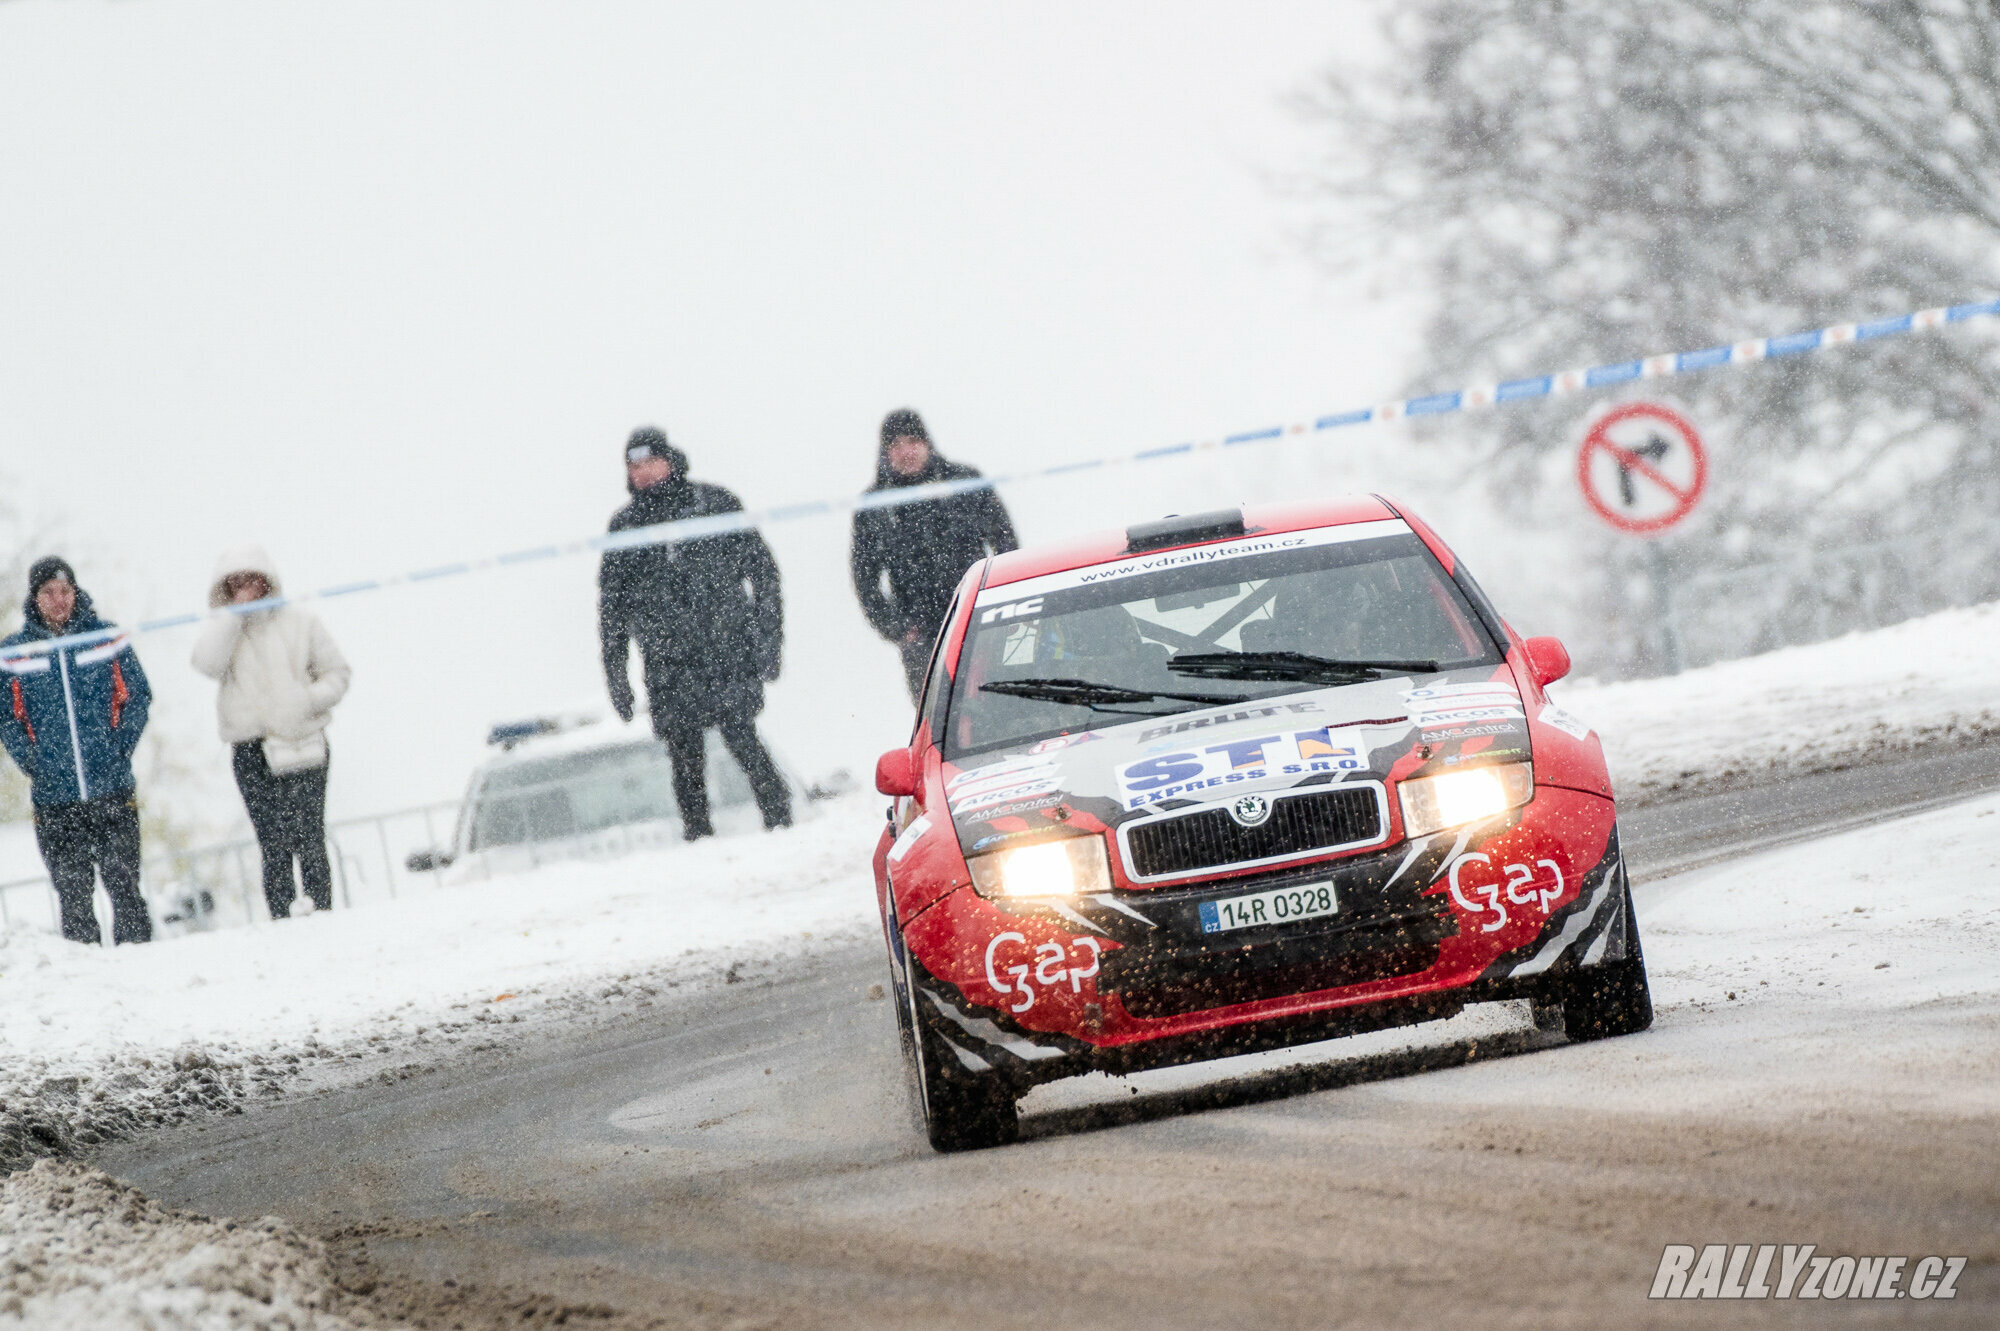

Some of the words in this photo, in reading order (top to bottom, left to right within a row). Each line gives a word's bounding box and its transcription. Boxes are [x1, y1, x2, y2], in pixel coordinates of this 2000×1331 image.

[1080, 536, 1307, 583] www.vdrallyteam.cz
[1137, 701, 1326, 744] BRUTE
[1420, 708, 1506, 722] ARCOS
[1421, 723, 1516, 740] AMControl
[1124, 727, 1356, 791] STL
[961, 780, 1055, 807] ARCOS
[1130, 768, 1267, 808] EXPRESS
[1282, 758, 1366, 775] S.R.O.
[966, 794, 1064, 821] AMControl
[1223, 898, 1267, 928] 14R
[1273, 887, 1332, 918] 0328
[1205, 921, 1220, 934] CZ
